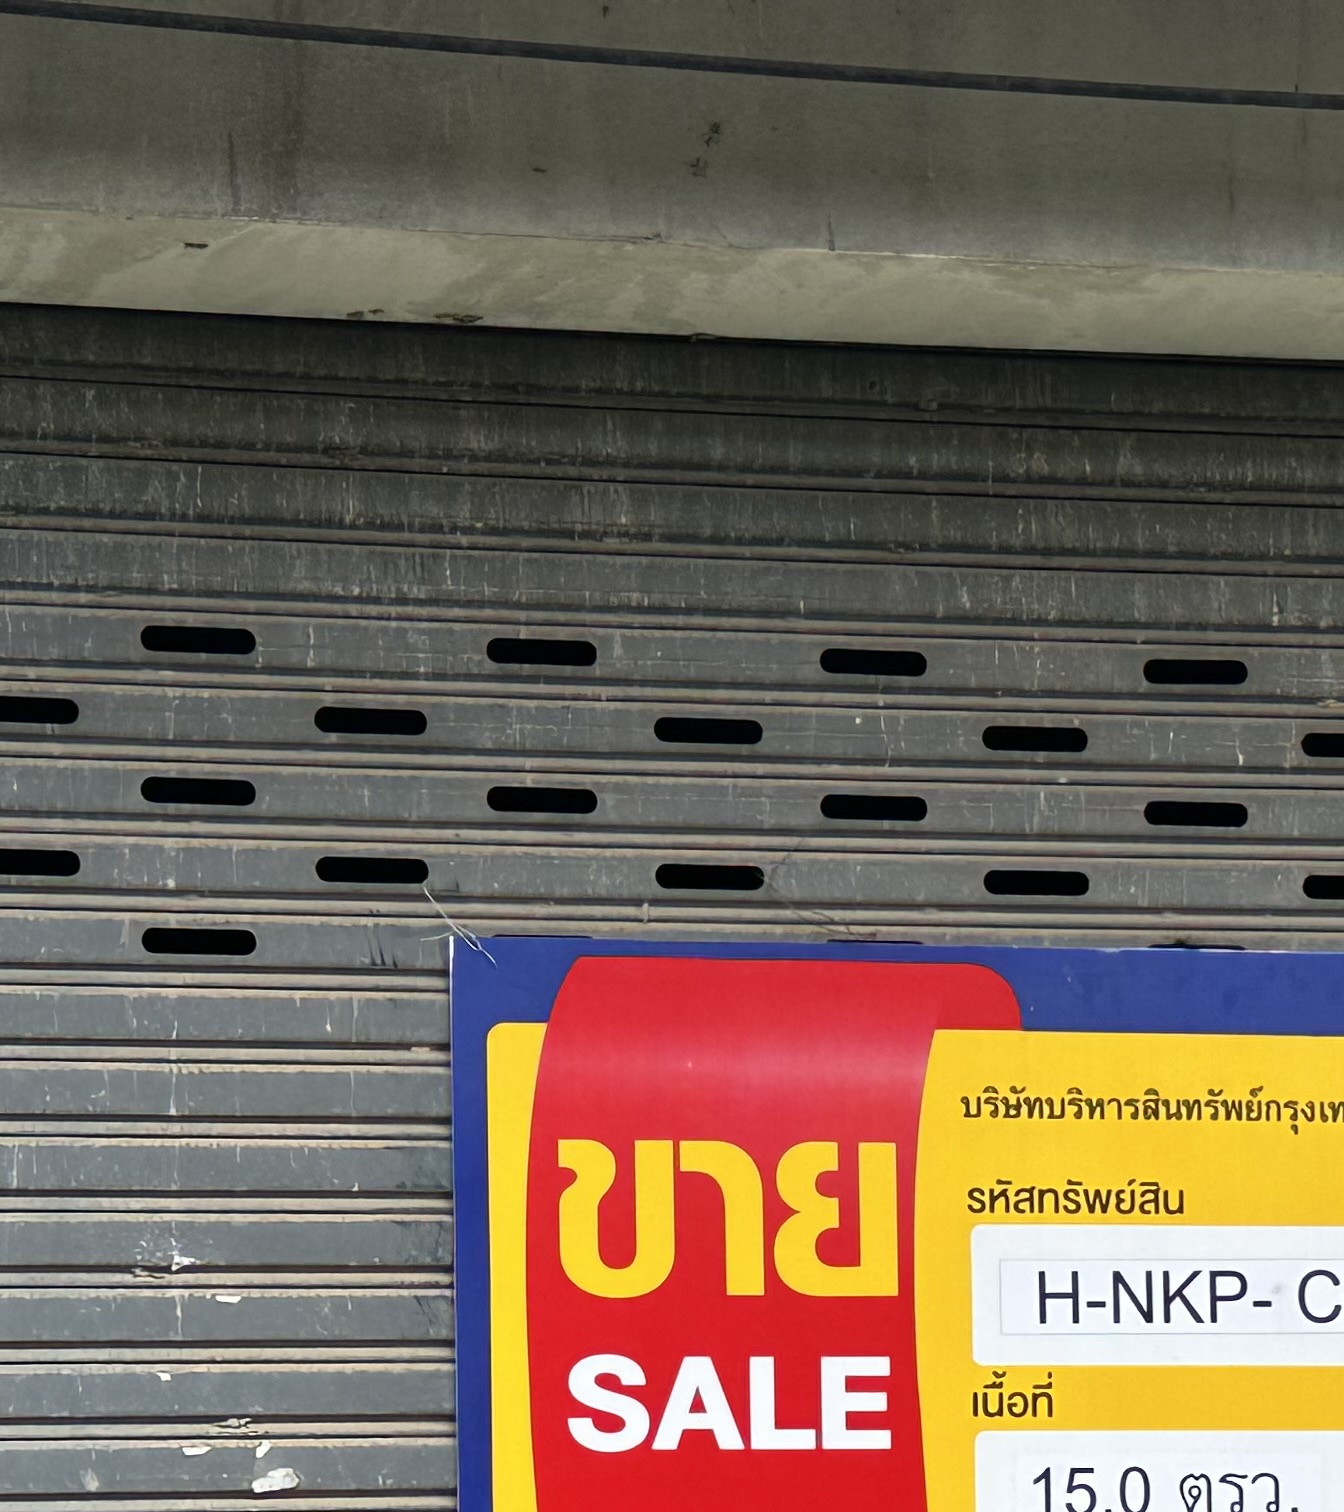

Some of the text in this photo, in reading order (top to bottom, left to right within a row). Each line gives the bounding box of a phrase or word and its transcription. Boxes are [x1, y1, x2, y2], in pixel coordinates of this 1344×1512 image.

[557, 1138, 899, 1299] ขาย
[966, 1178, 1185, 1215] รหัสทรัพย์สิน
[1037, 1269, 1273, 1325] H-NKP-
[567, 1353, 892, 1454] SALE
[971, 1370, 1054, 1419] เนื้อที่
